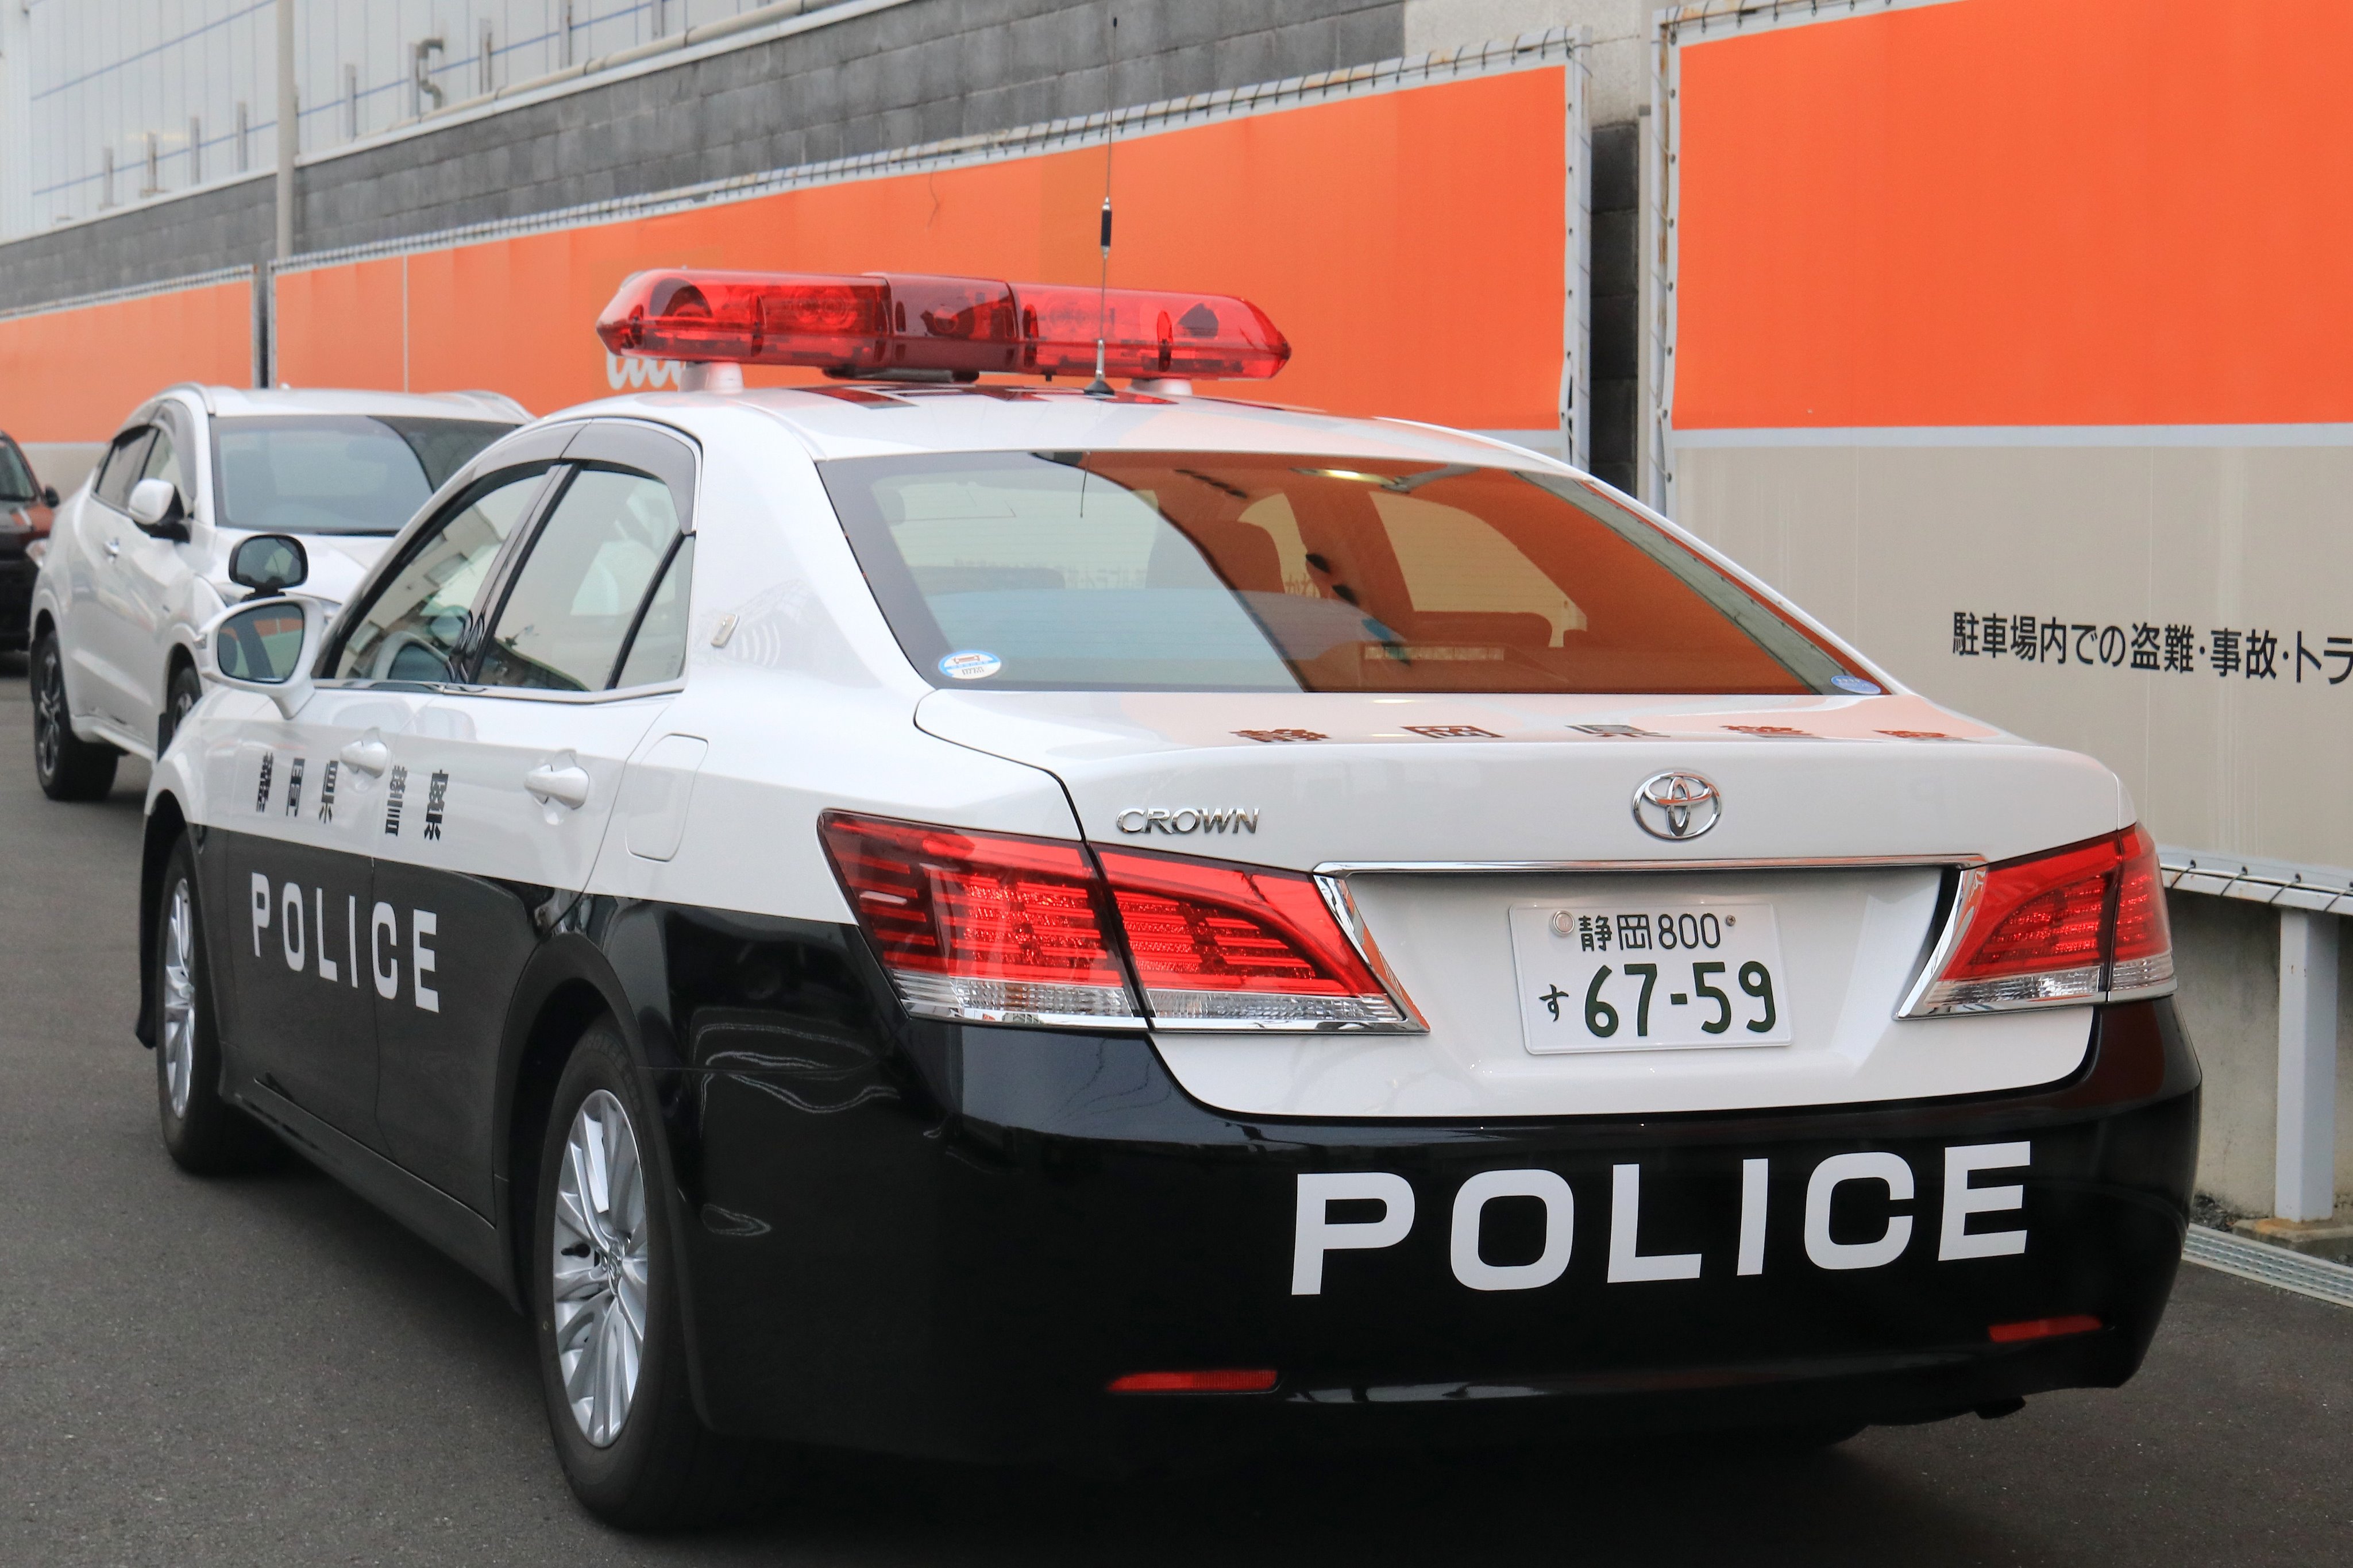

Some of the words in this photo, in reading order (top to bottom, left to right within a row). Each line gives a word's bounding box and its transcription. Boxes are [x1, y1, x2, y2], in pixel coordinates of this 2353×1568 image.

[1116, 806, 1260, 835] CROWN
[251, 871, 439, 1013] POLICE
[1538, 983, 1569, 1022] す
[1584, 960, 1776, 1038] 67-59
[1291, 1140, 2031, 1296] POLICE
